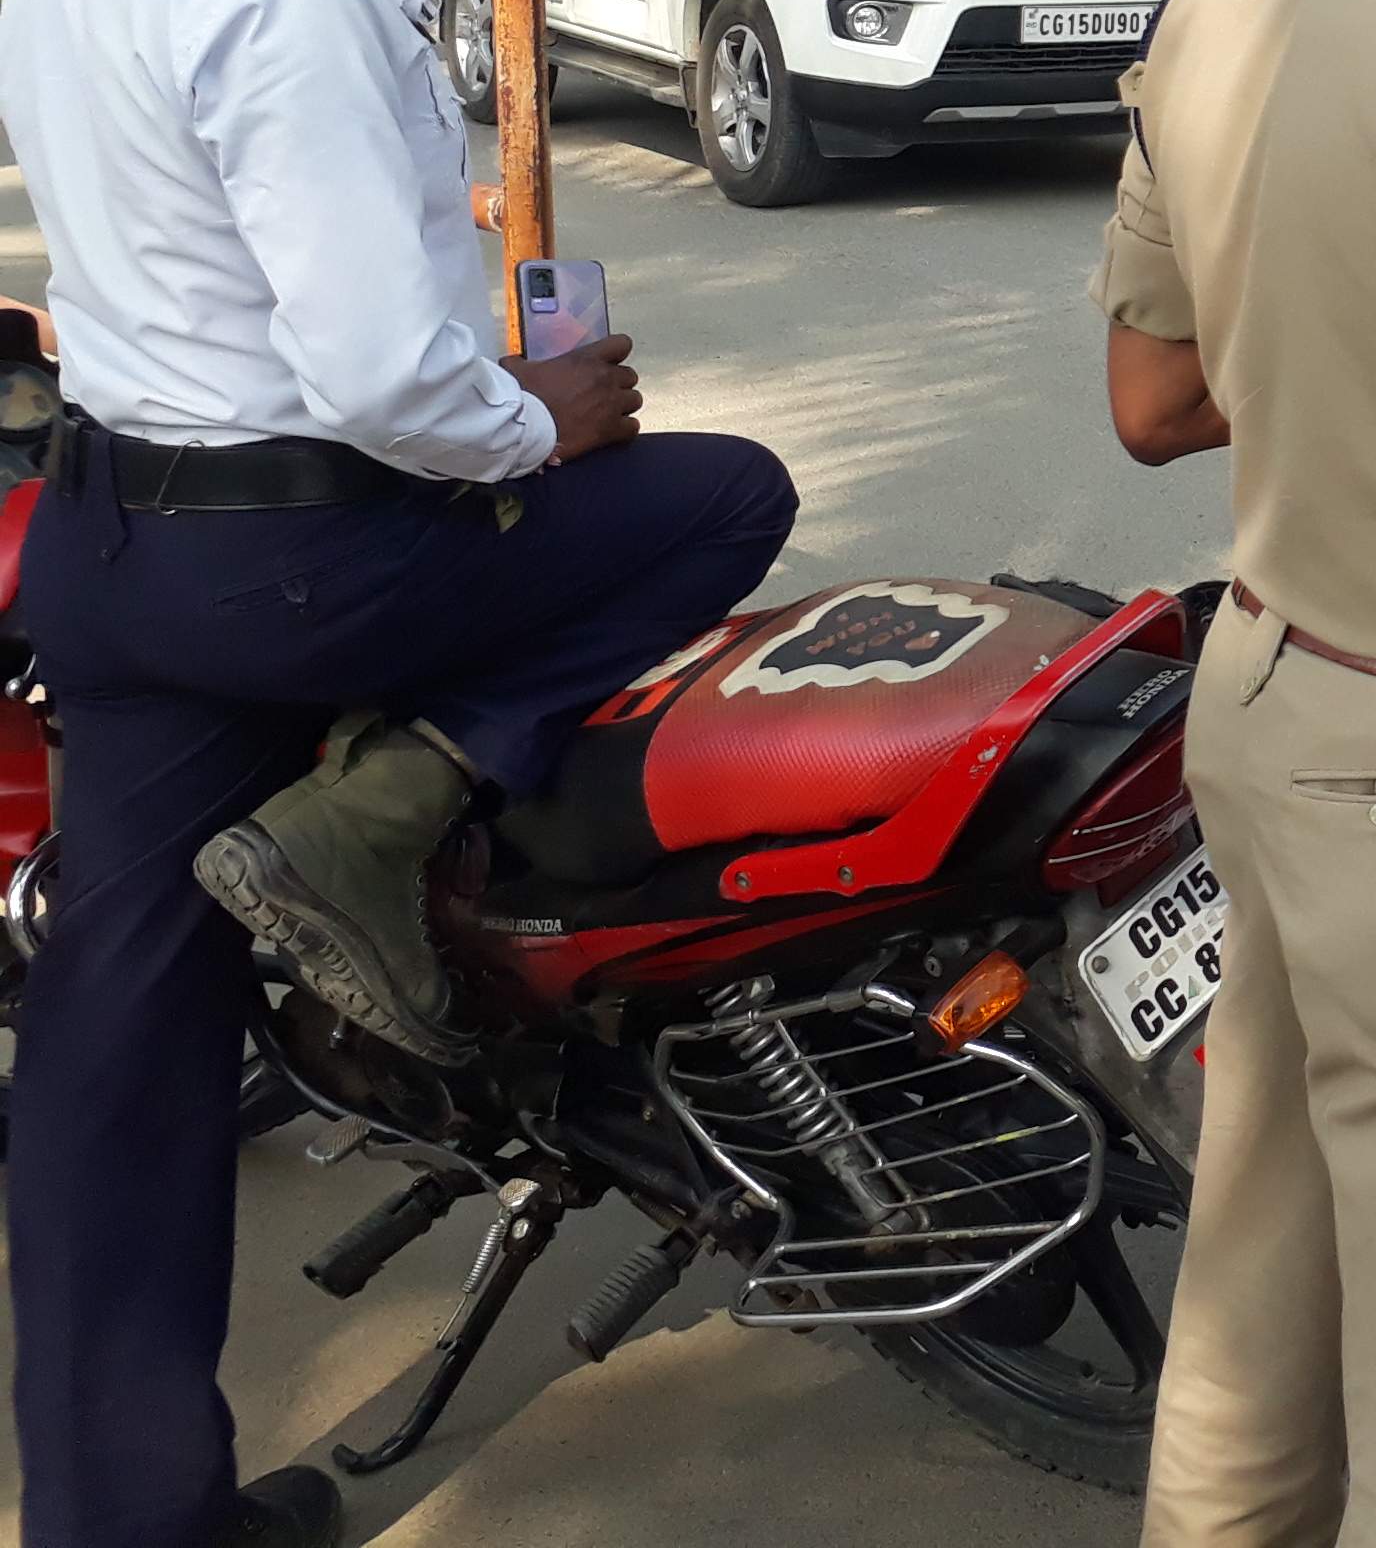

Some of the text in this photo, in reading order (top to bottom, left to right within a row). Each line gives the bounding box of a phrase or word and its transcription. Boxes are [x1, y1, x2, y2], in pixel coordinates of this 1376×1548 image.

[1121, 669, 1191, 720] HONDA
[516, 918, 563, 933] HONDA
[1128, 860, 1221, 959] CG15
[1130, 927, 1224, 1043] CC 8
